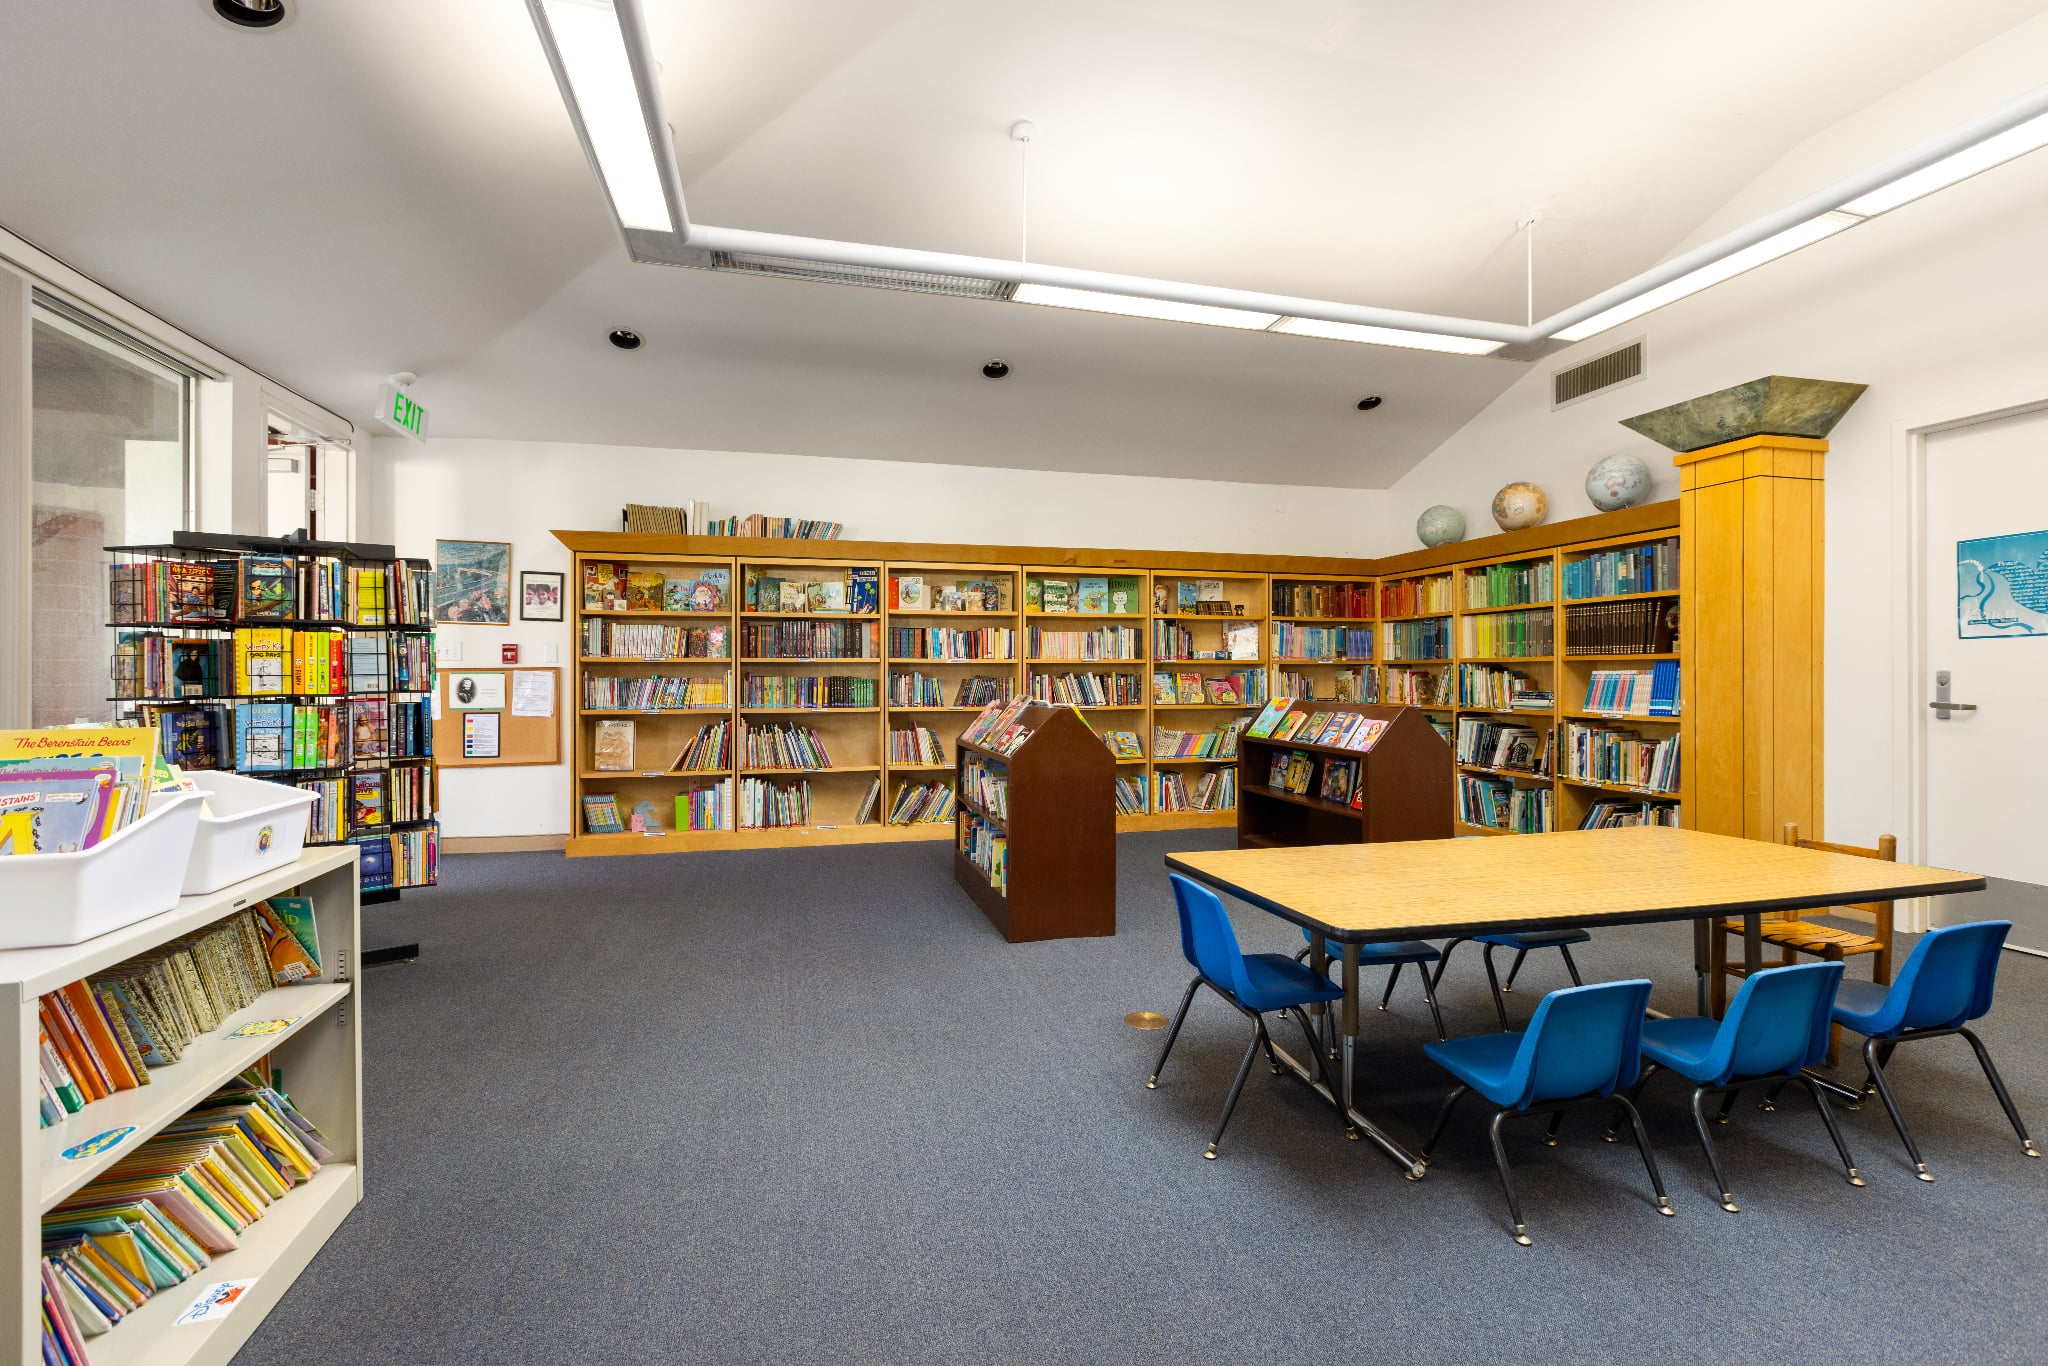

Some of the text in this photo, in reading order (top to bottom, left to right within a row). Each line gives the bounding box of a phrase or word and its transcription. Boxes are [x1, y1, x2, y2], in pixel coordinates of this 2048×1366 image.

[393, 391, 424, 435] EXIT
[15, 736, 136, 749] The Berenstain Bears'
[177, 1282, 235, 1324] Disney
